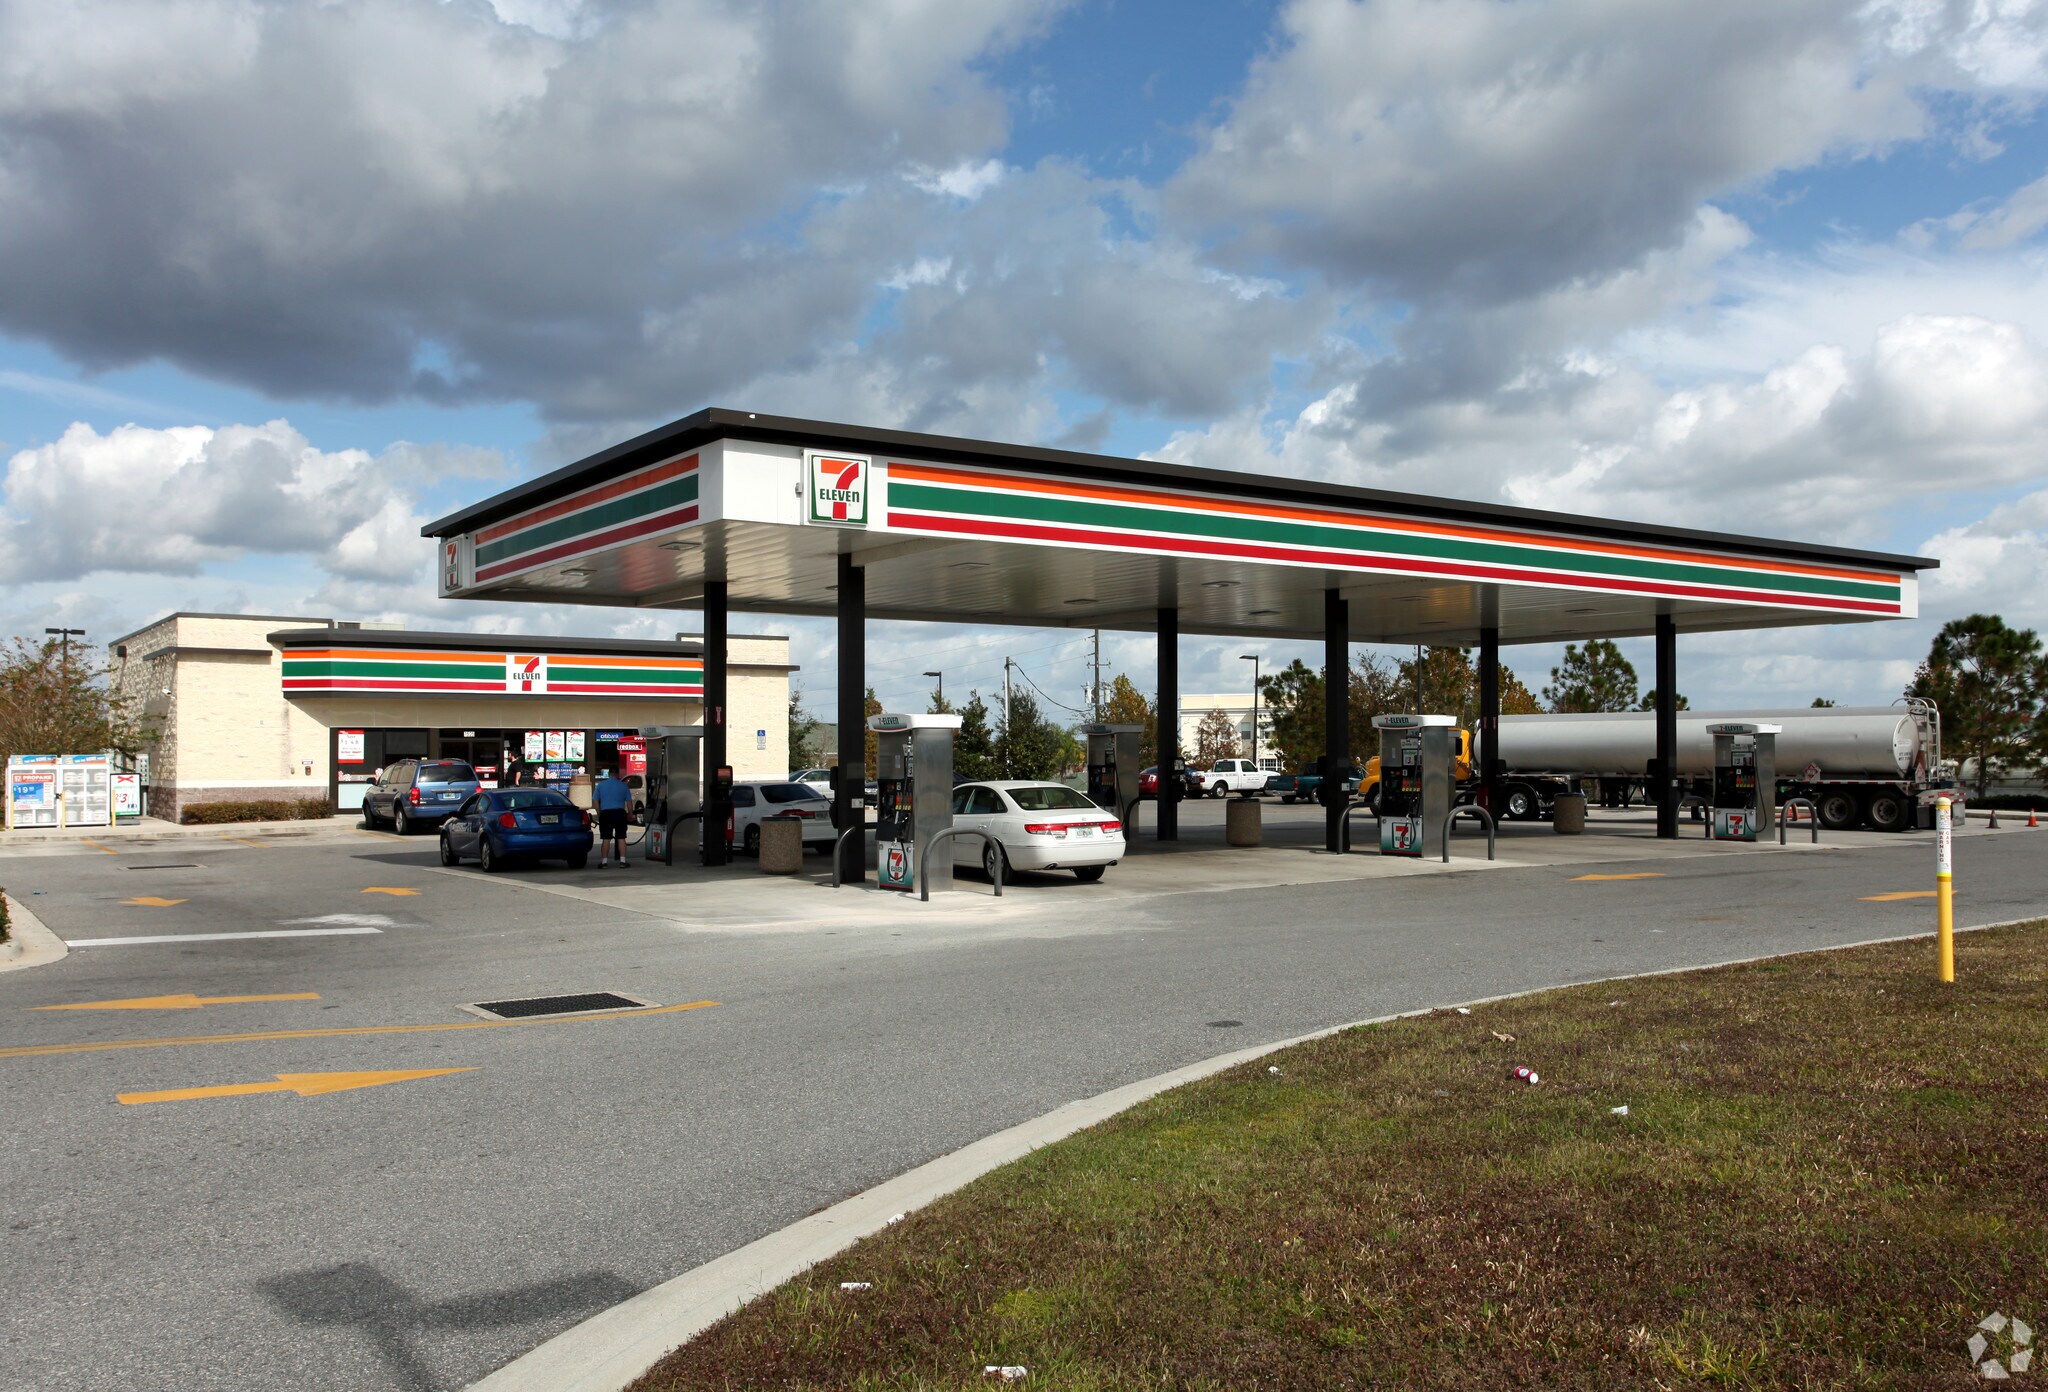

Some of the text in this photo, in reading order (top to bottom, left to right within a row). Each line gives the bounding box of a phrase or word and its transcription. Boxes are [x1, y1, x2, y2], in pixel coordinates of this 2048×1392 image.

[820, 458, 859, 520] 7
[447, 543, 456, 586] 7
[514, 656, 540, 691] 7
[1395, 825, 1409, 849] 7
[1729, 815, 1743, 834] 7
[891, 852, 903, 880] 7
